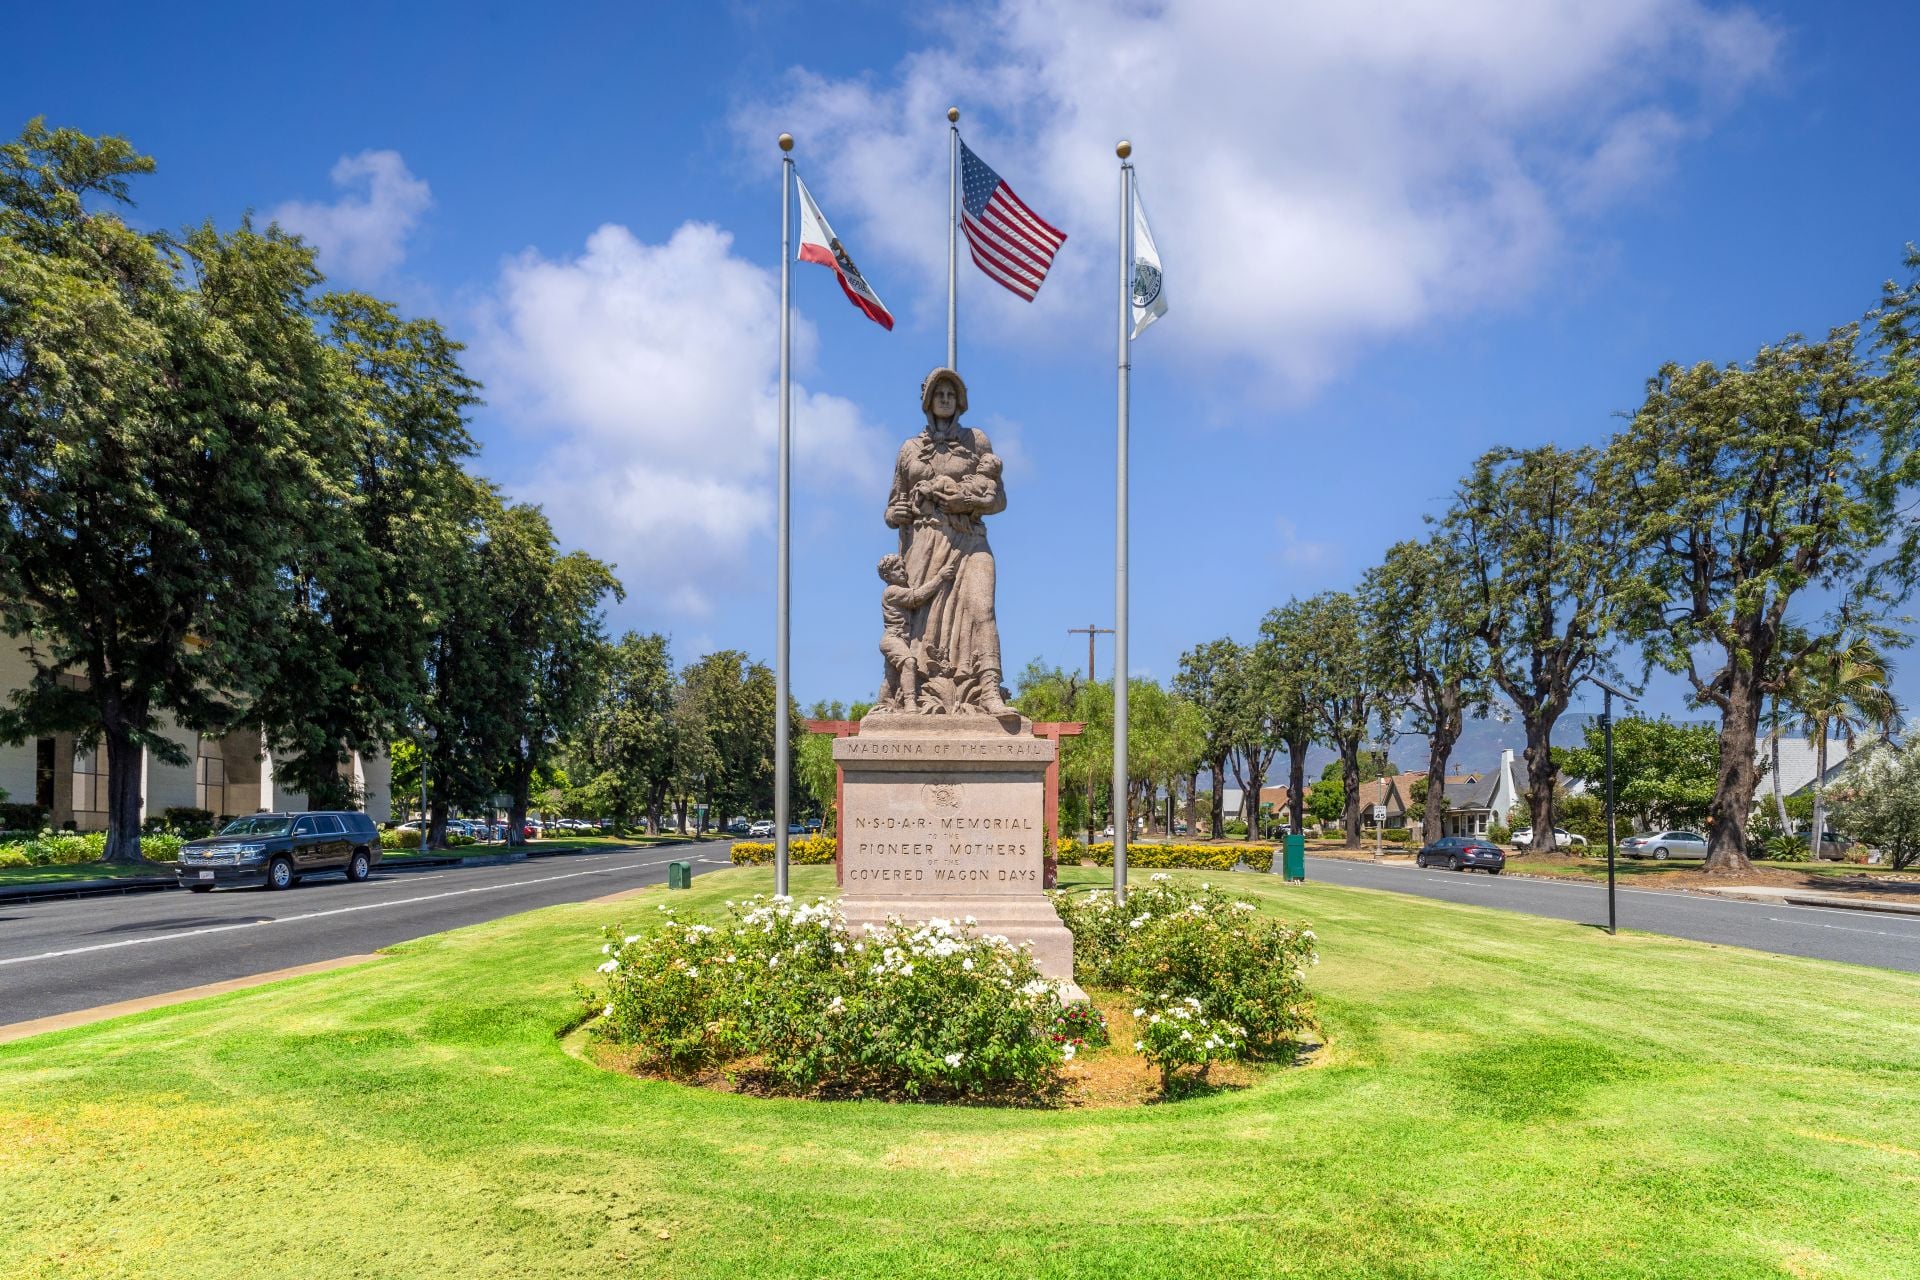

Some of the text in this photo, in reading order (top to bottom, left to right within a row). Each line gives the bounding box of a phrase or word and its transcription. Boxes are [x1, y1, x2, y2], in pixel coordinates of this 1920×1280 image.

[848, 744, 1040, 755] MADONNA OF THE TRAIL
[941, 818, 1032, 830] MEMORIAL
[859, 843, 1027, 856] PIONEER MOTHERS
[850, 869, 1036, 881] COVERED WAGON DAYS
